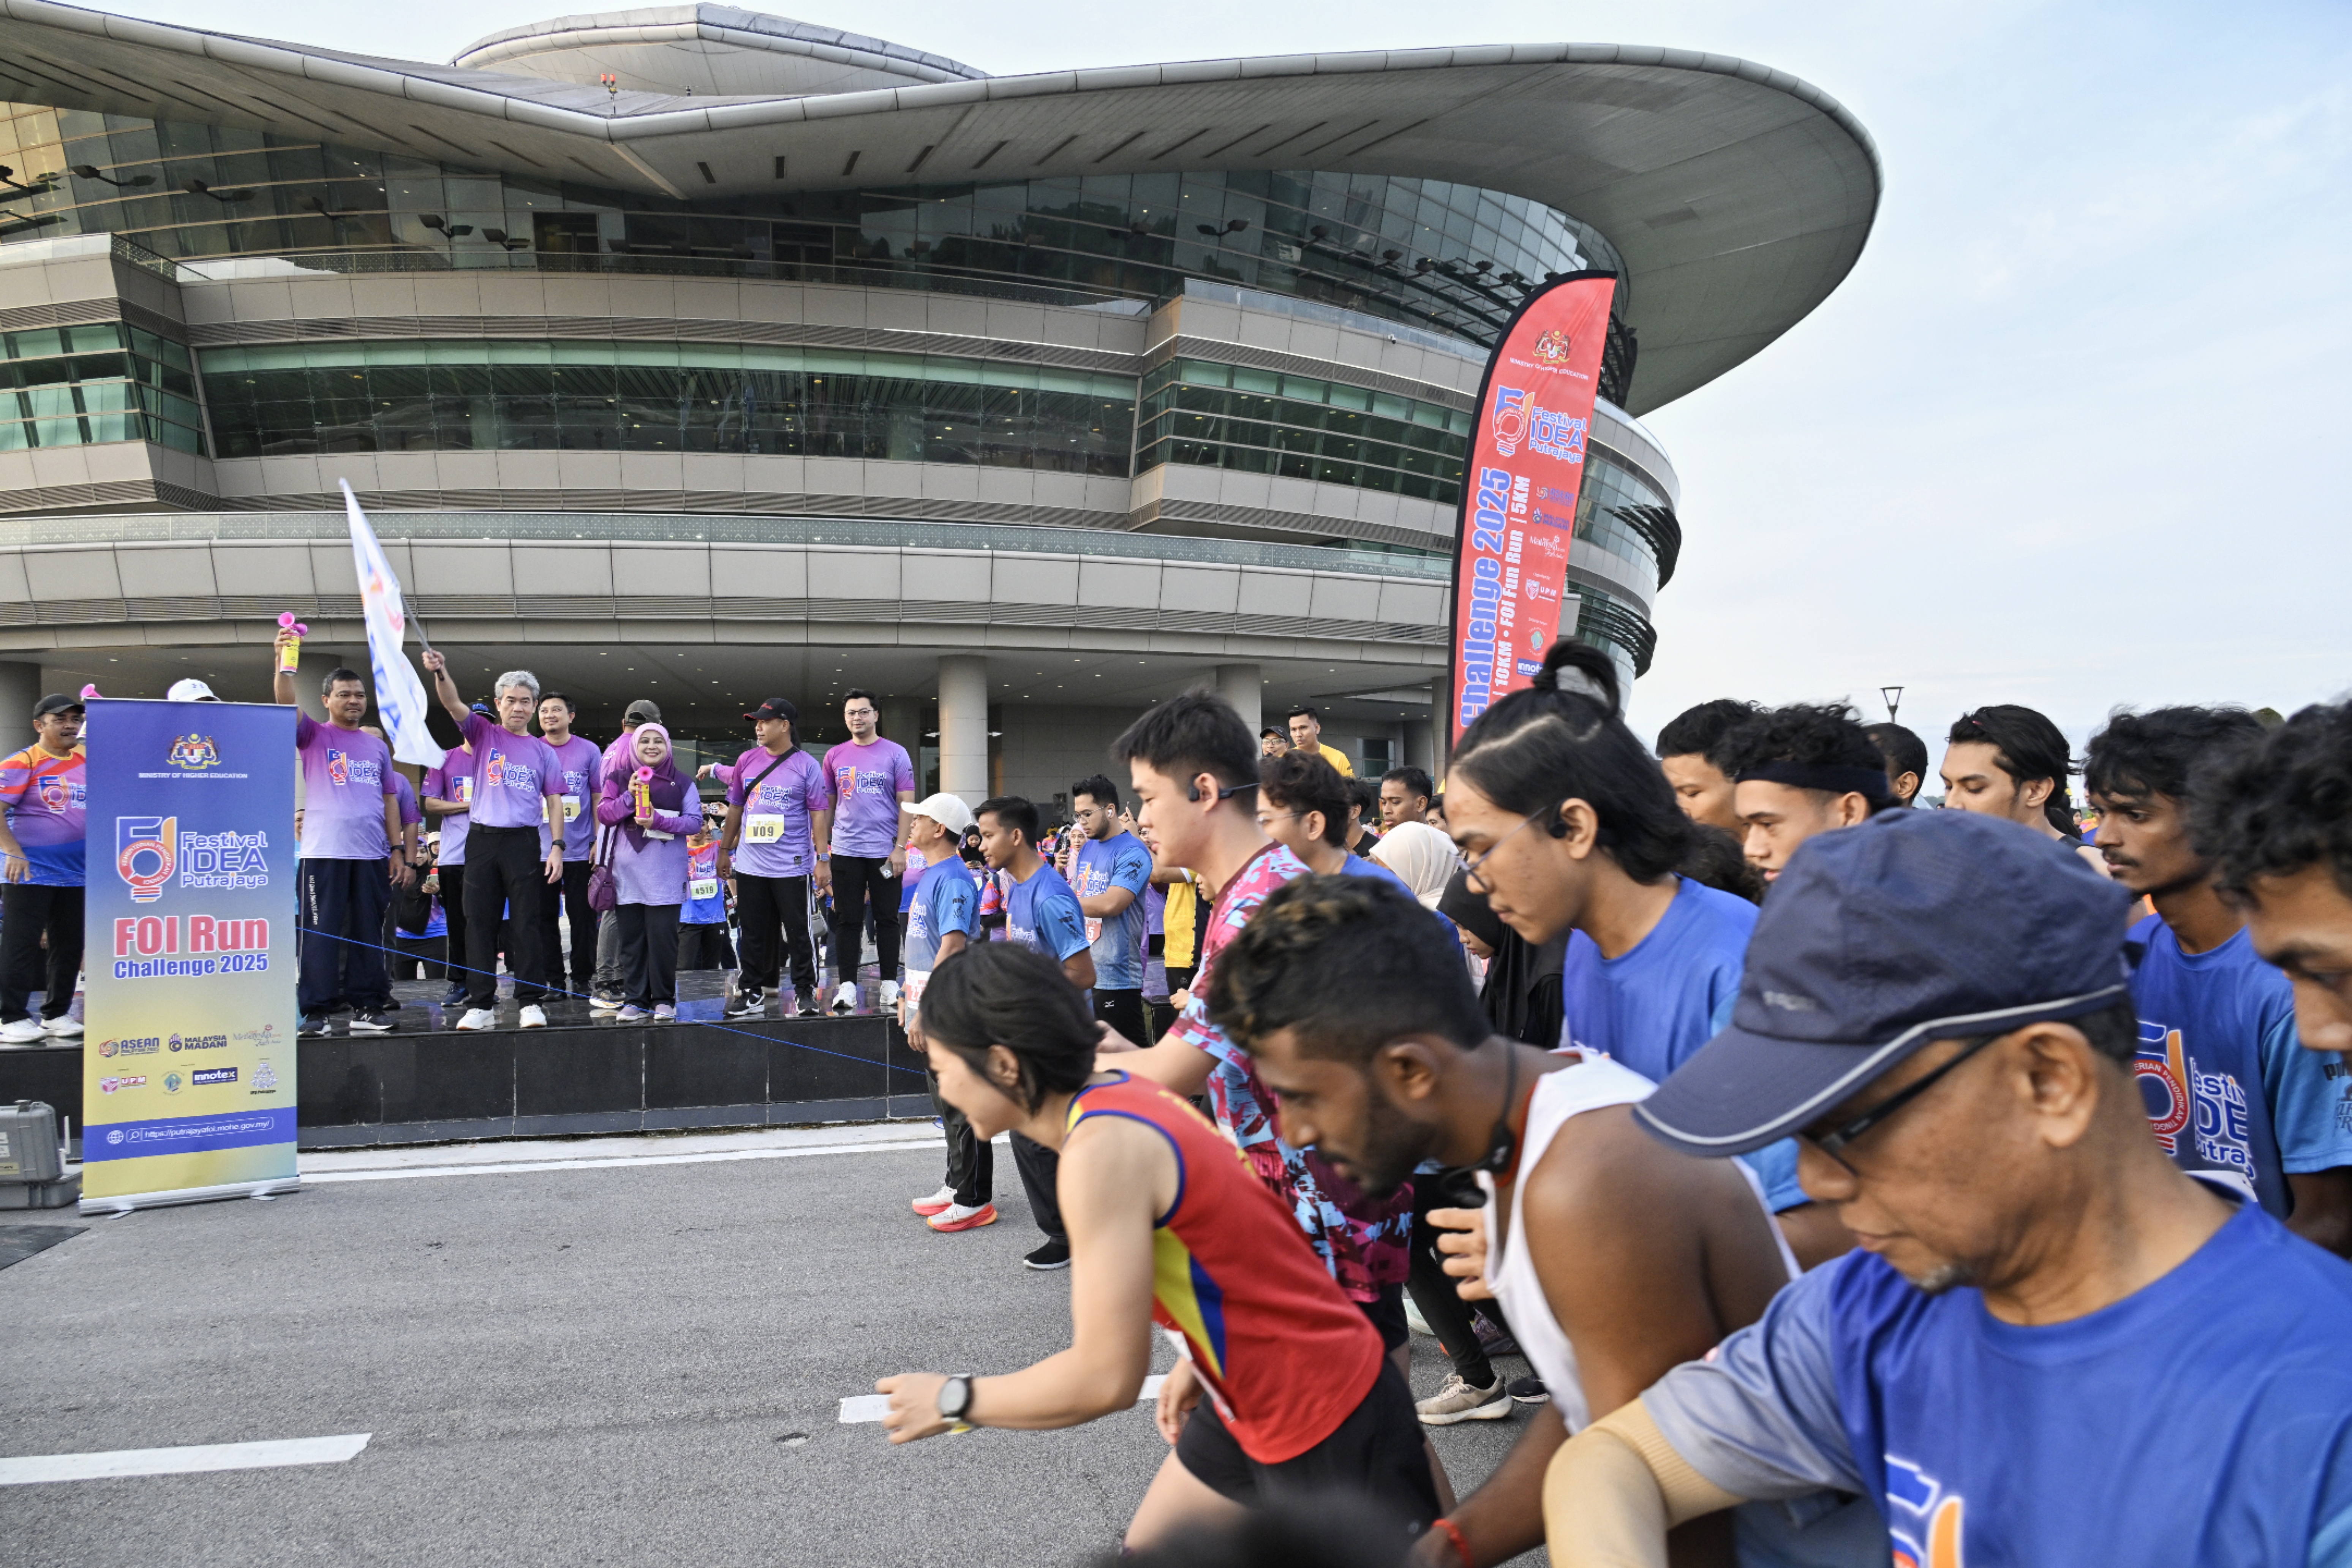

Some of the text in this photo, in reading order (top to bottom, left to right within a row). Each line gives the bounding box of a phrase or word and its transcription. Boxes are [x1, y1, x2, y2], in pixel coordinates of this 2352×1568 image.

[1532, 405, 1587, 432] Festival
[1530, 419, 1584, 452] IDEA
[1528, 439, 1582, 464] Putrajaya
[1494, 475, 1530, 687] 10KM FOI Fun Run 5KM
[1460, 467, 1512, 728] Challenge 2025
[1517, 662, 1541, 673] innot
[857, 777, 884, 788] IDEA
[760, 791, 789, 803] IDEA
[180, 831, 268, 848] Festival
[753, 826, 774, 837] V09
[182, 847, 268, 874] IDEA
[180, 872, 268, 889] Putrajaya
[114, 915, 269, 957] FOI Run
[114, 953, 268, 979] Challenge 2025
[121, 1037, 160, 1049] ASEAN
[184, 1041, 227, 1050] MADANI
[121, 1076, 146, 1085] UPM
[194, 1070, 236, 1081] innotex
[2162, 1070, 2185, 1122] PENDIDIKAN
[2195, 1090, 2247, 1143] DE
